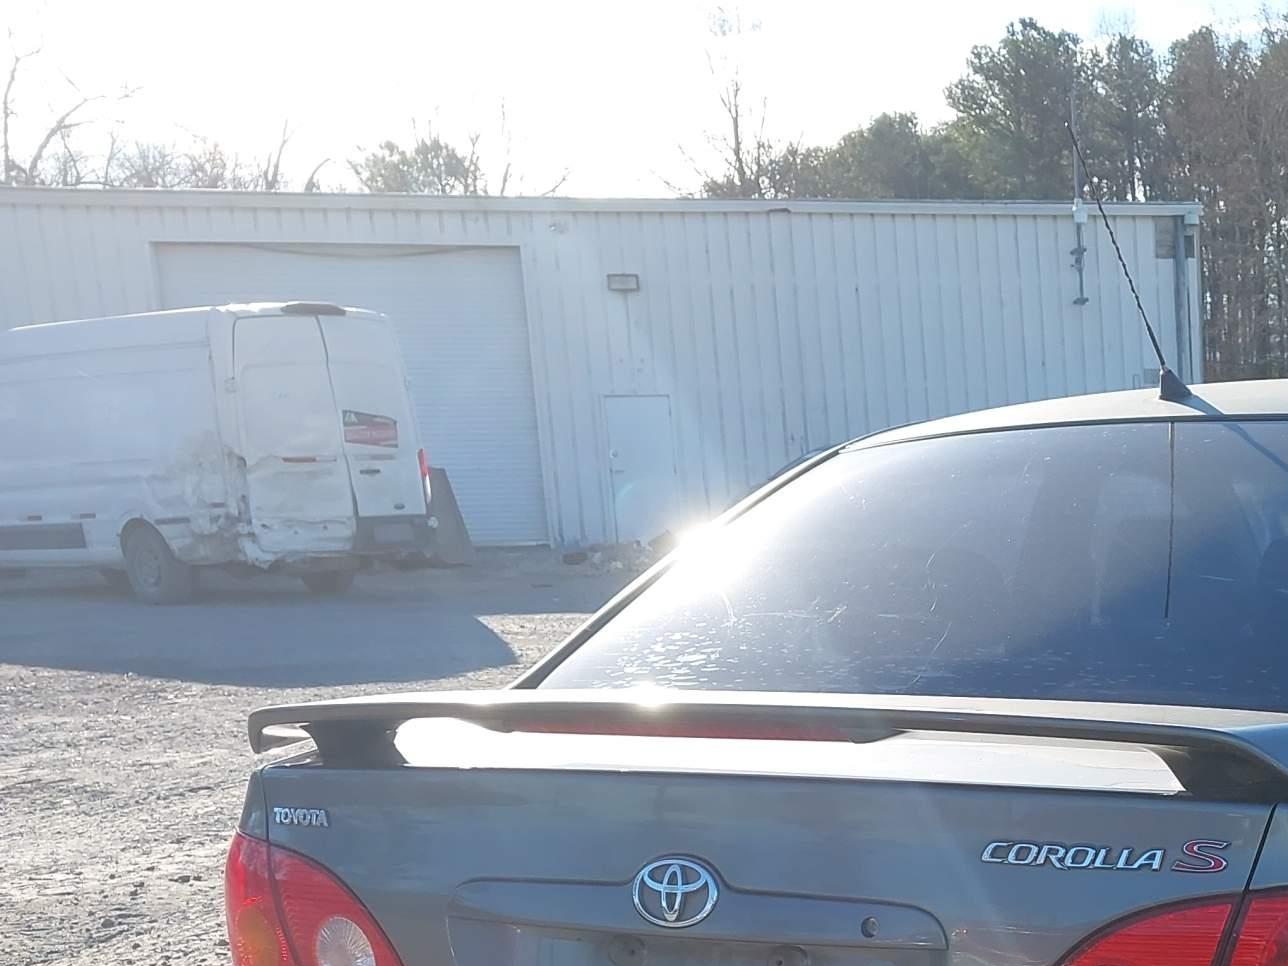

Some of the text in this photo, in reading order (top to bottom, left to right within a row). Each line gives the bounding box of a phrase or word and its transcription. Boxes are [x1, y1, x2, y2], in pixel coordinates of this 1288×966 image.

[273, 807, 328, 827] TOYOTA
[981, 839, 1231, 873] COROLLA S
